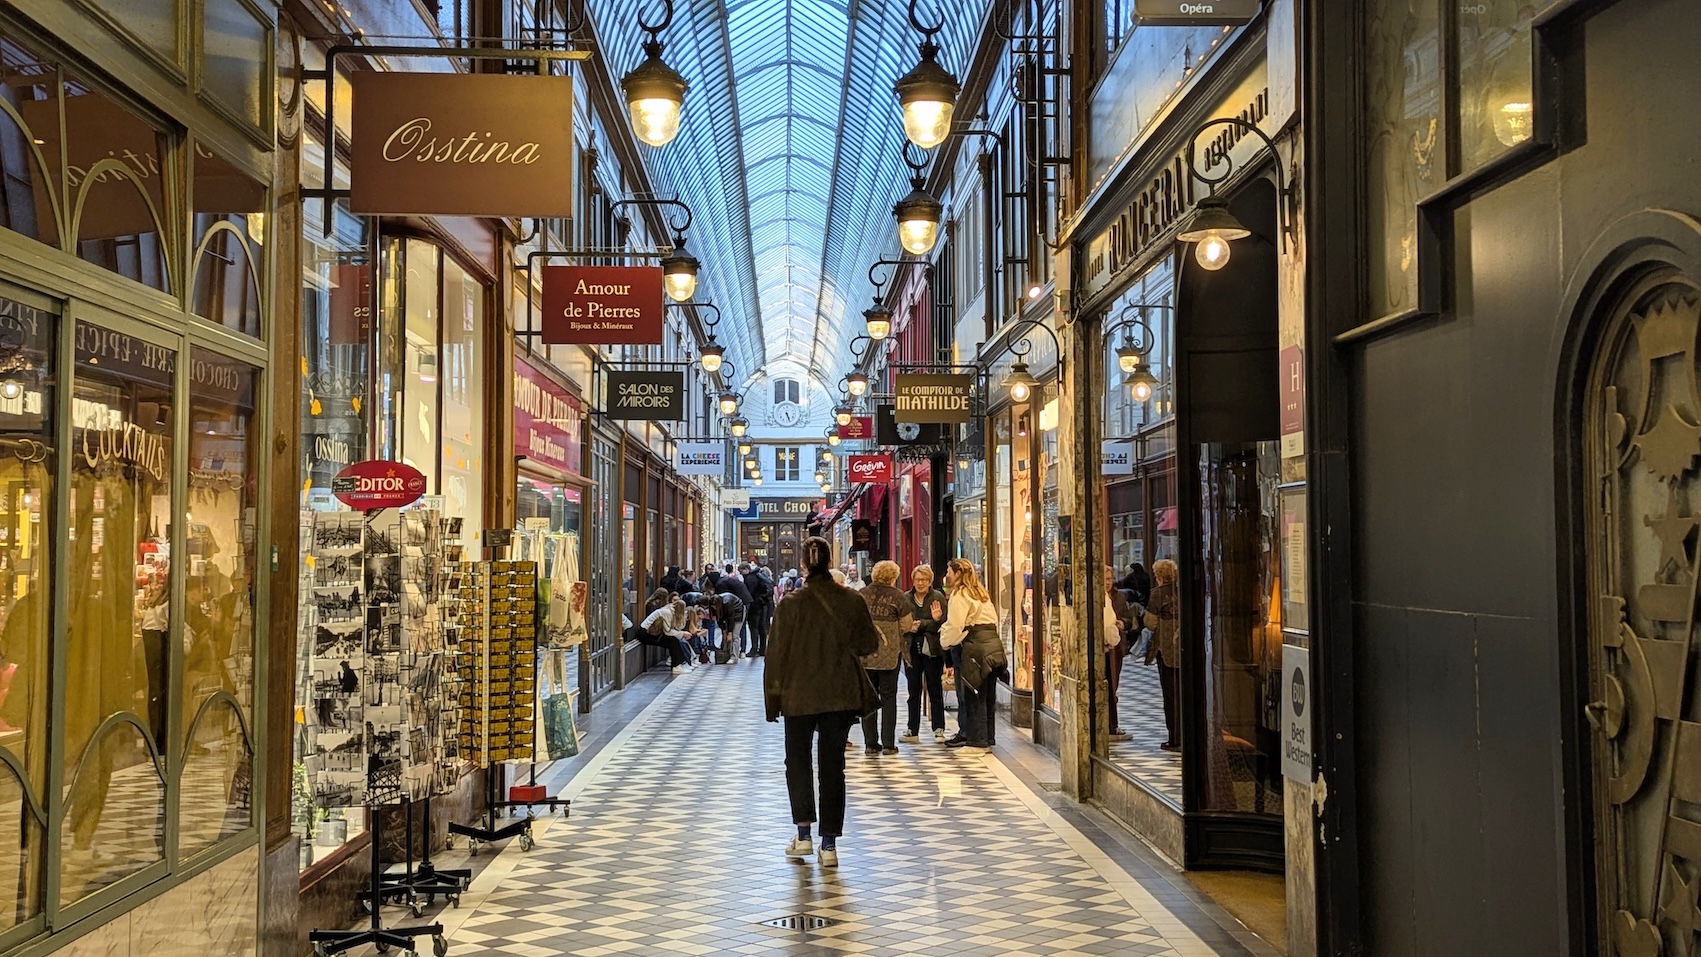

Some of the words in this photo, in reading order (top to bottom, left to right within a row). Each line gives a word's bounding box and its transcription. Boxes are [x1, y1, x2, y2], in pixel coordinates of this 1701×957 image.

[1180, 3, 1213, 15] Opéra
[382, 117, 541, 165] Osstina
[574, 279, 631, 296] Amour
[564, 302, 582, 318] de
[587, 302, 640, 318] Pierres
[570, 321, 592, 331] Bijoux
[602, 321, 633, 330] Minéraux
[1291, 361, 1300, 392] H
[618, 383, 658, 395] SALON
[660, 385, 674, 394] DES
[911, 386, 953, 395] COMPTOIR
[617, 396, 670, 408] MIROIRS
[897, 395, 969, 410] MATHILDE
[83, 411, 165, 481] COCKTAILS
[758, 502, 779, 513] OTEL
[1291, 721, 1305, 746] Best
[1286, 740, 1311, 768] Western
